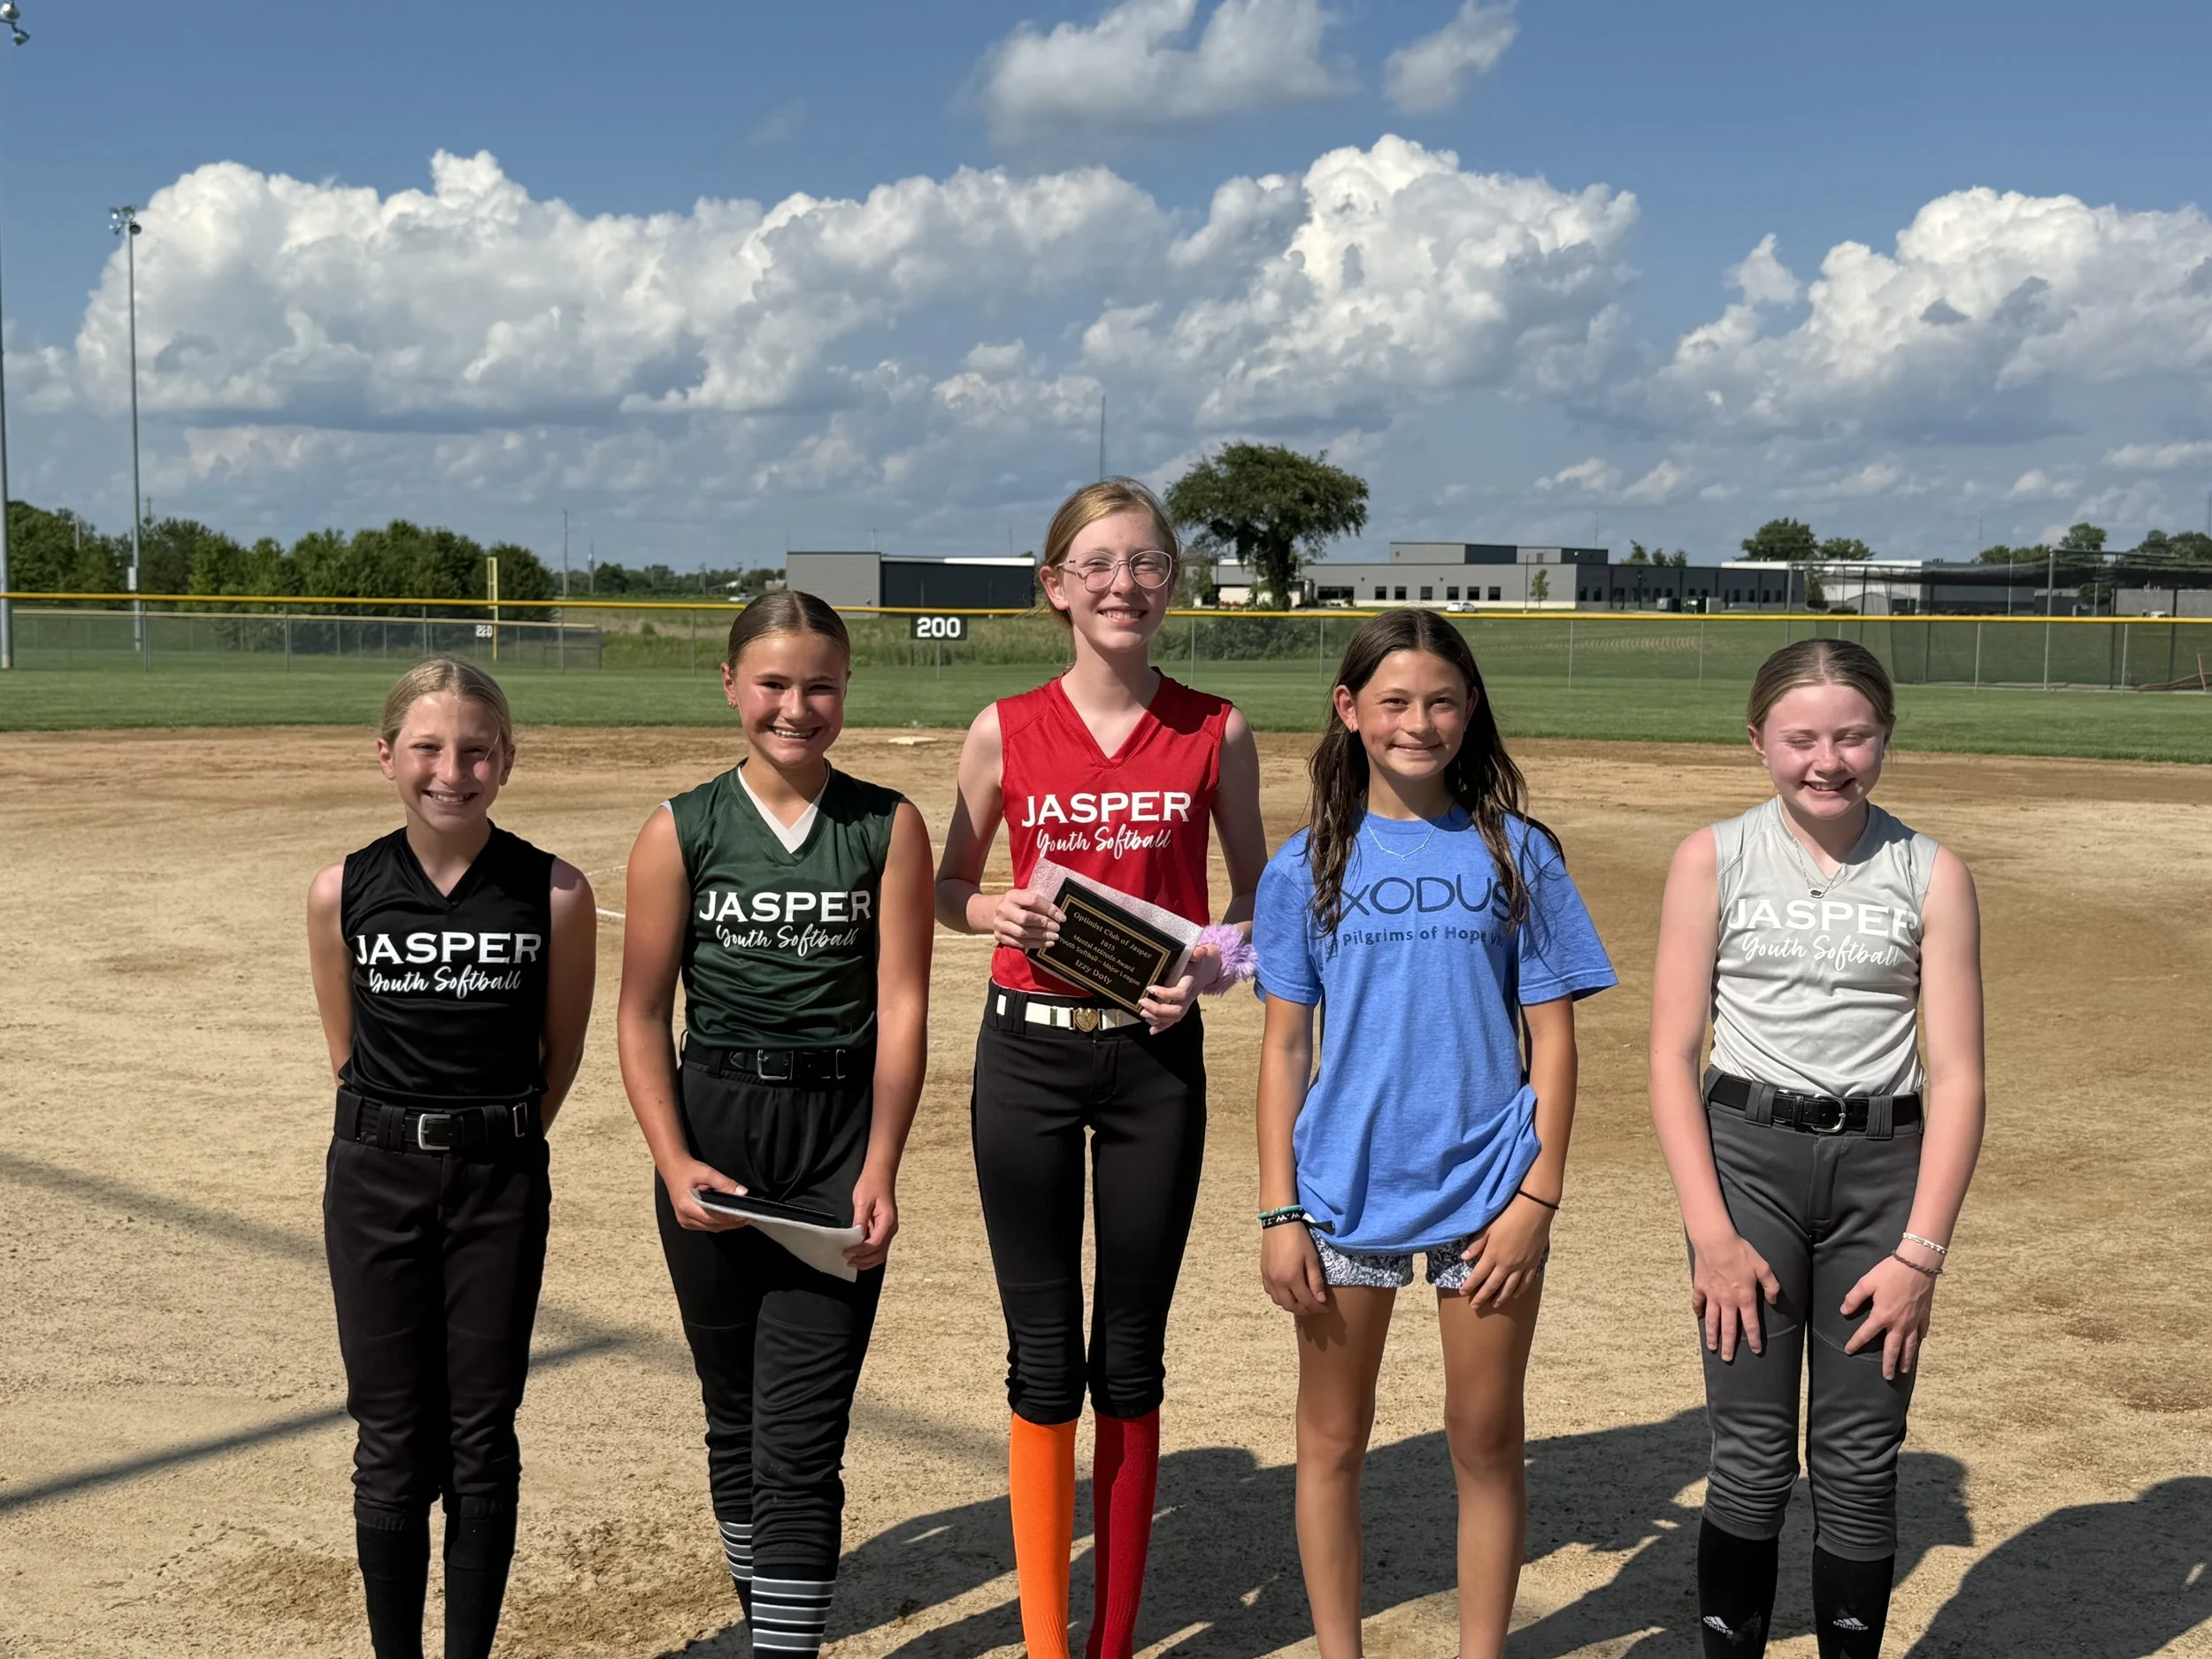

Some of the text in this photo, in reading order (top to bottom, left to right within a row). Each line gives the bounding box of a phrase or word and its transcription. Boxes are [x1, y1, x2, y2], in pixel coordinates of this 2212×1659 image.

[917, 617, 961, 638] 200
[1021, 791, 1191, 828] JASPER
[1036, 823, 1171, 860] Youth Softball
[699, 890, 872, 923] JASPER
[1338, 873, 1512, 923] XODUS
[1073, 911, 1104, 933] Optimist
[1103, 928, 1120, 941] Club
[1129, 943, 1153, 959] Jasper
[1342, 927, 1414, 947] Pilgrims
[1419, 926, 1438, 941] of
[1444, 926, 1486, 944] Hope
[1727, 898, 1918, 939] JASPER
[356, 931, 541, 965] JASPER
[716, 923, 860, 957] Youth Softball
[1741, 933, 1901, 972] Youth Softball
[368, 964, 521, 1000] Youth Softball
[1092, 968, 1113, 985] Doty
